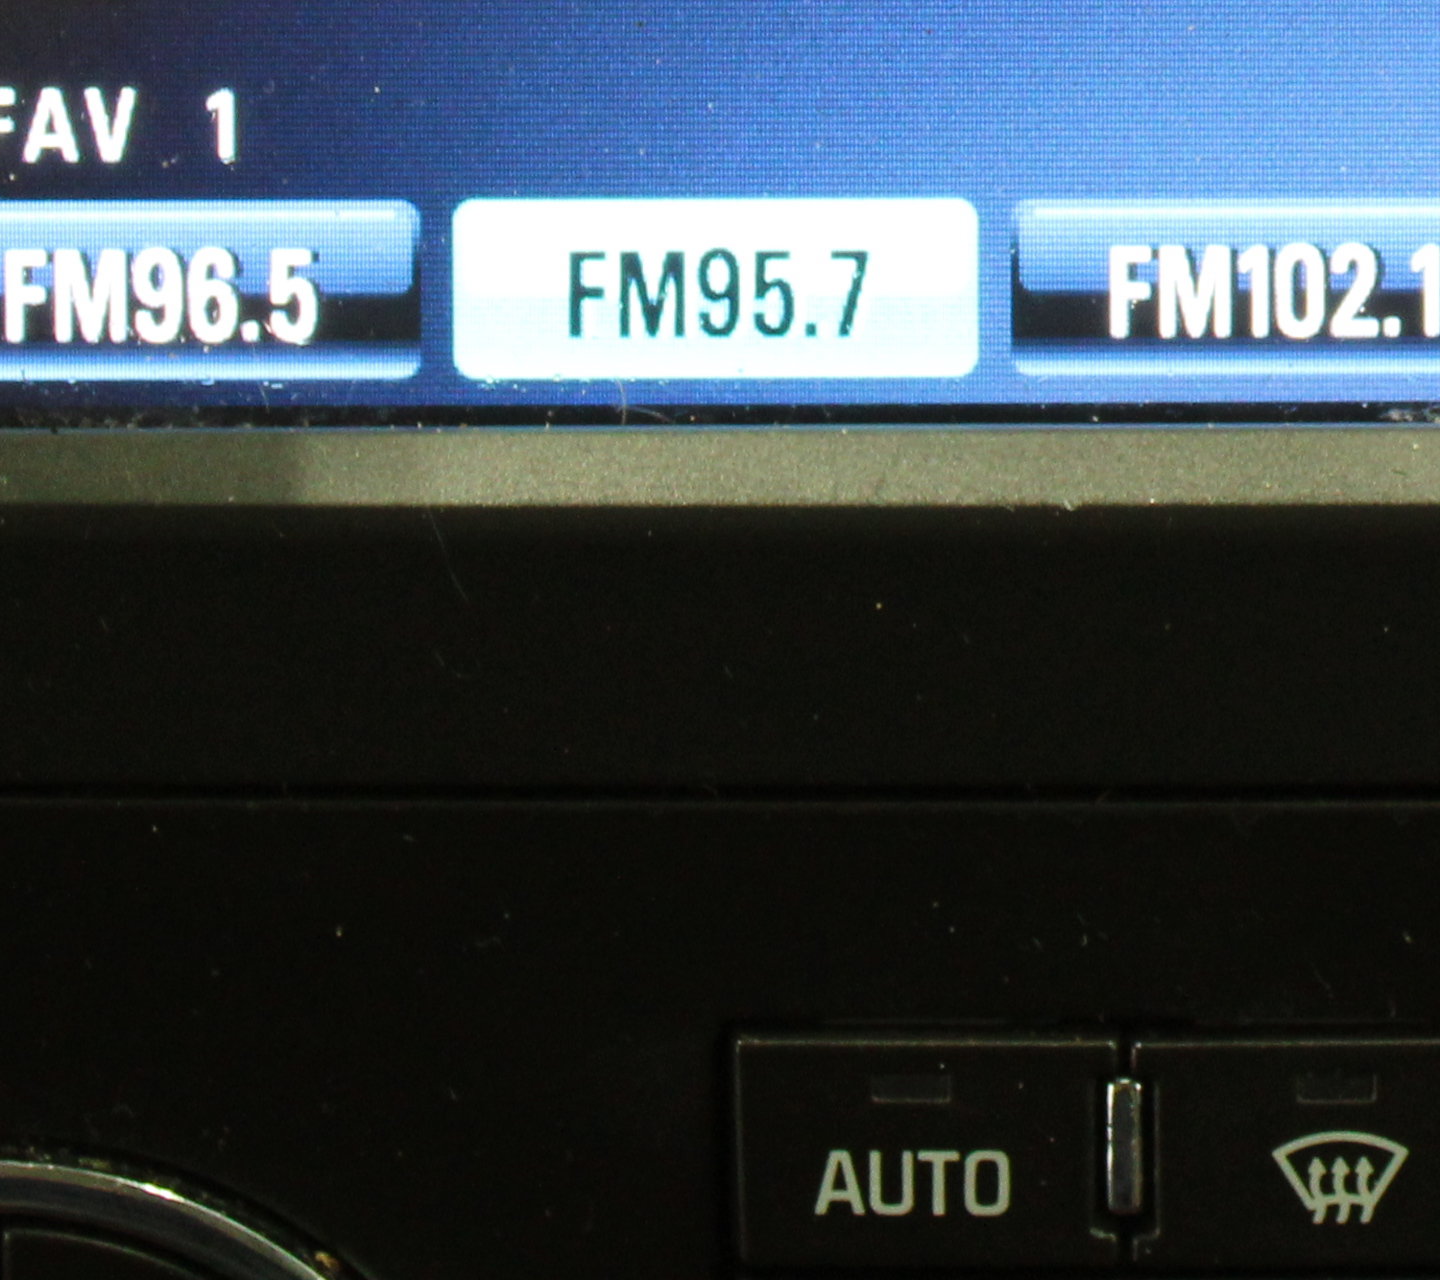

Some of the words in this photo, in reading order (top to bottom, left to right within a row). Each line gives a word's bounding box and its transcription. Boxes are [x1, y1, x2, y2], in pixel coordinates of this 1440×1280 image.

[205, 88, 242, 162] 1
[2, 246, 320, 345] FM96.5
[568, 248, 869, 339] FM95.7
[815, 1149, 1010, 1216] AUTO
